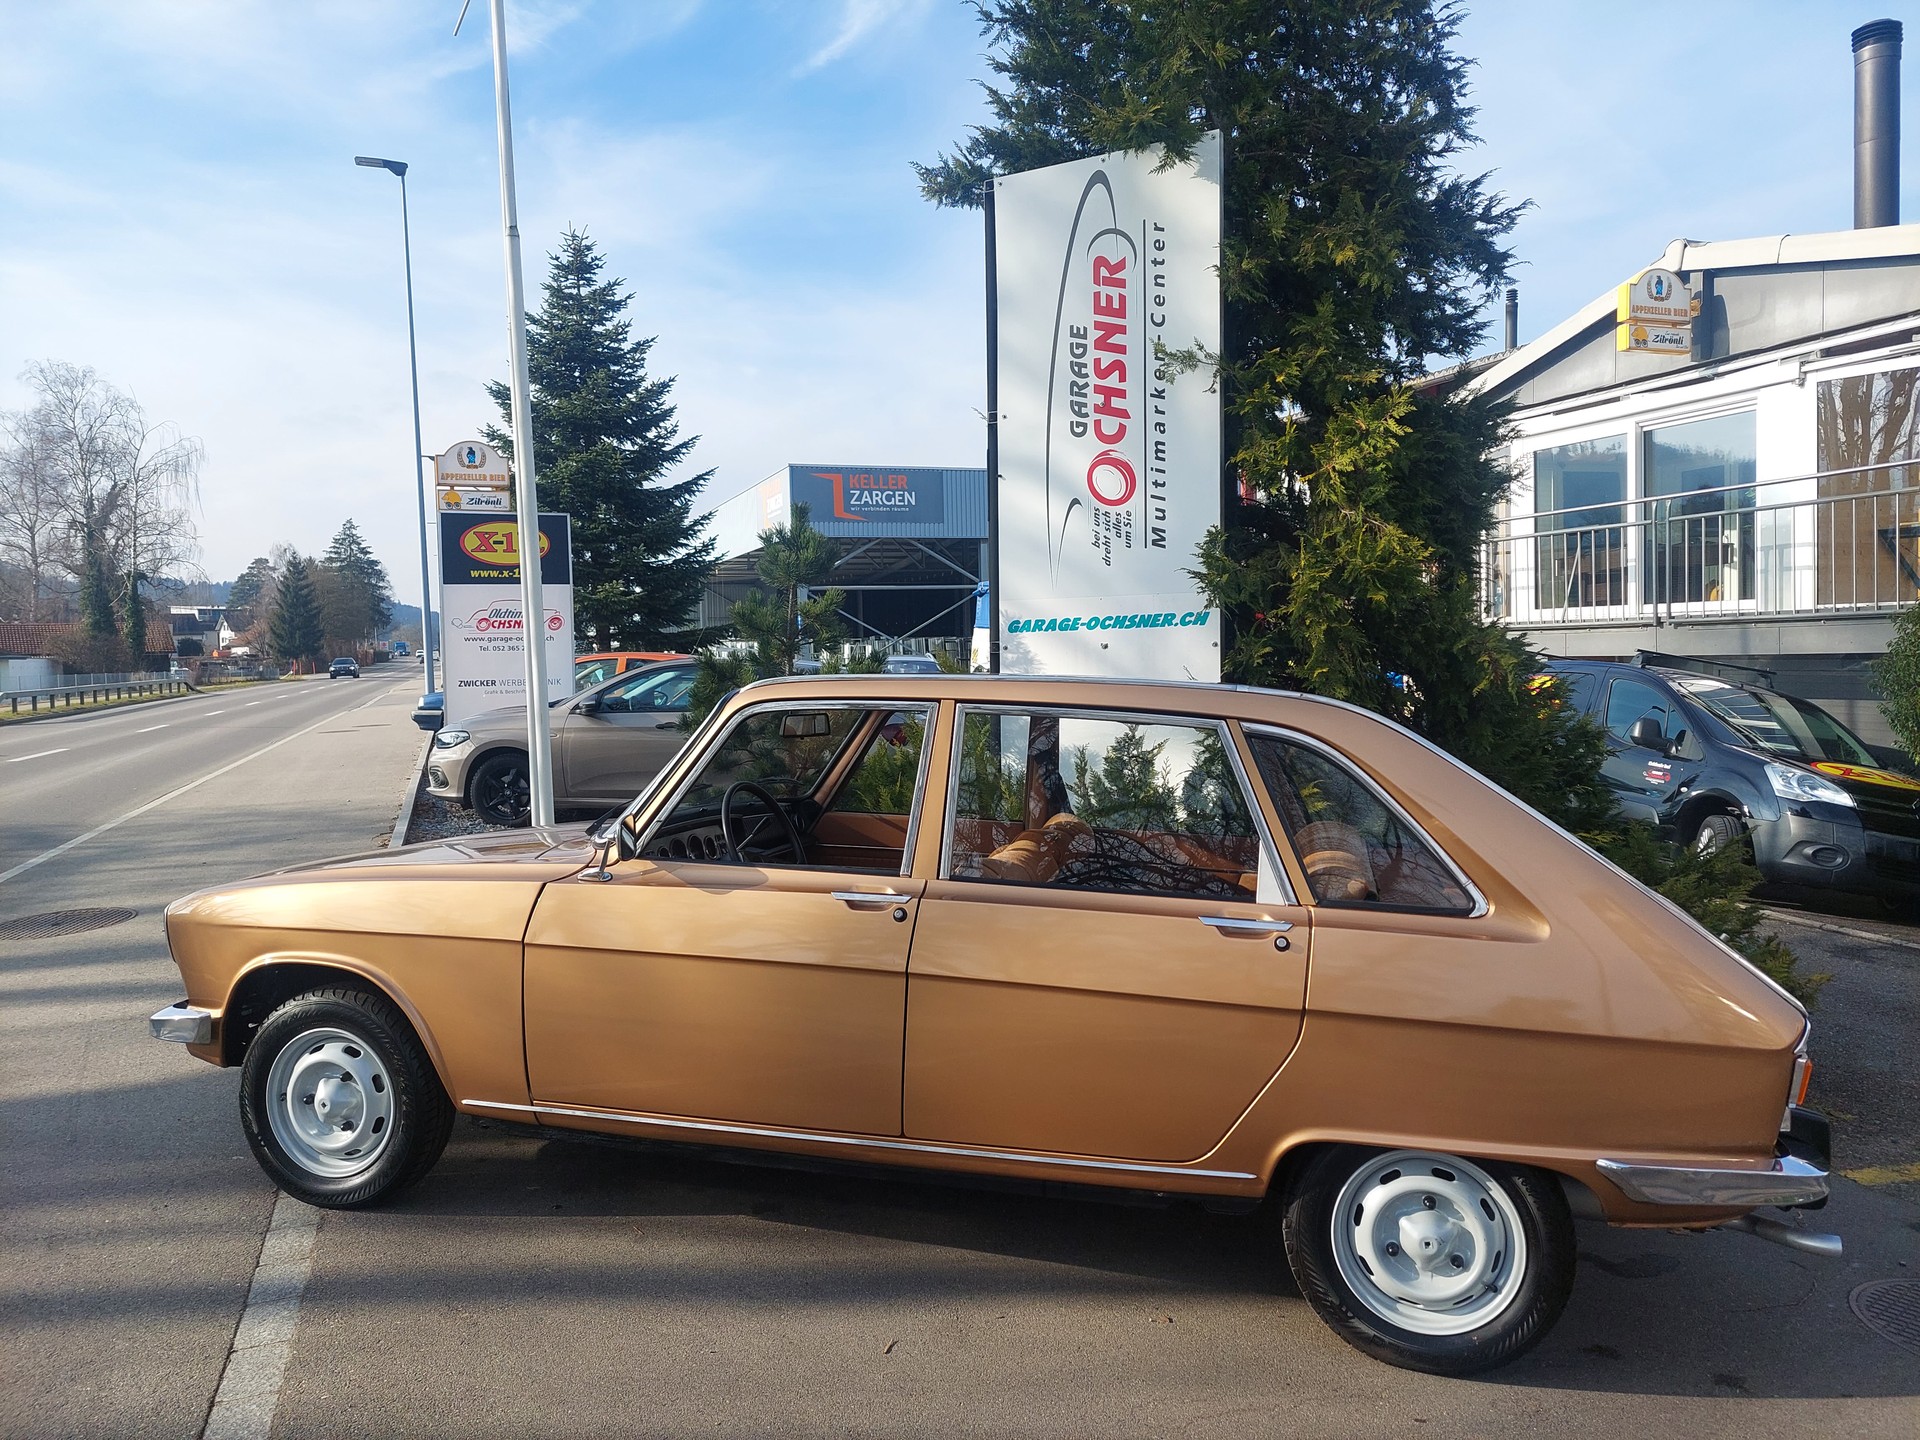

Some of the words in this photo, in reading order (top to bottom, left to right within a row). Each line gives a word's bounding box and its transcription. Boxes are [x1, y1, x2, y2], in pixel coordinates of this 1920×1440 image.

[1673, 307, 1688, 317] BIER
[1069, 324, 1090, 438] GARAGE
[1086, 255, 1137, 507] OCHSNER
[850, 474, 908, 489] KELLER
[850, 491, 916, 506] ZARGEN
[1101, 510, 1111, 533] sich
[1112, 512, 1122, 539] alles
[1123, 510, 1132, 529] Sie
[471, 532, 545, 553] X-1
[1091, 529, 1101, 549] bei
[1124, 530, 1132, 549] um
[1101, 535, 1112, 567] dreht
[470, 568, 520, 577] www.x-1
[488, 608, 523, 619] Oldtim
[1007, 611, 1211, 634] GARAGE-OCHSNER.CH
[476, 618, 524, 632] OCHSN
[464, 635, 555, 643] www.garage-oc.ch
[499, 678, 562, 687] WERBENIK
